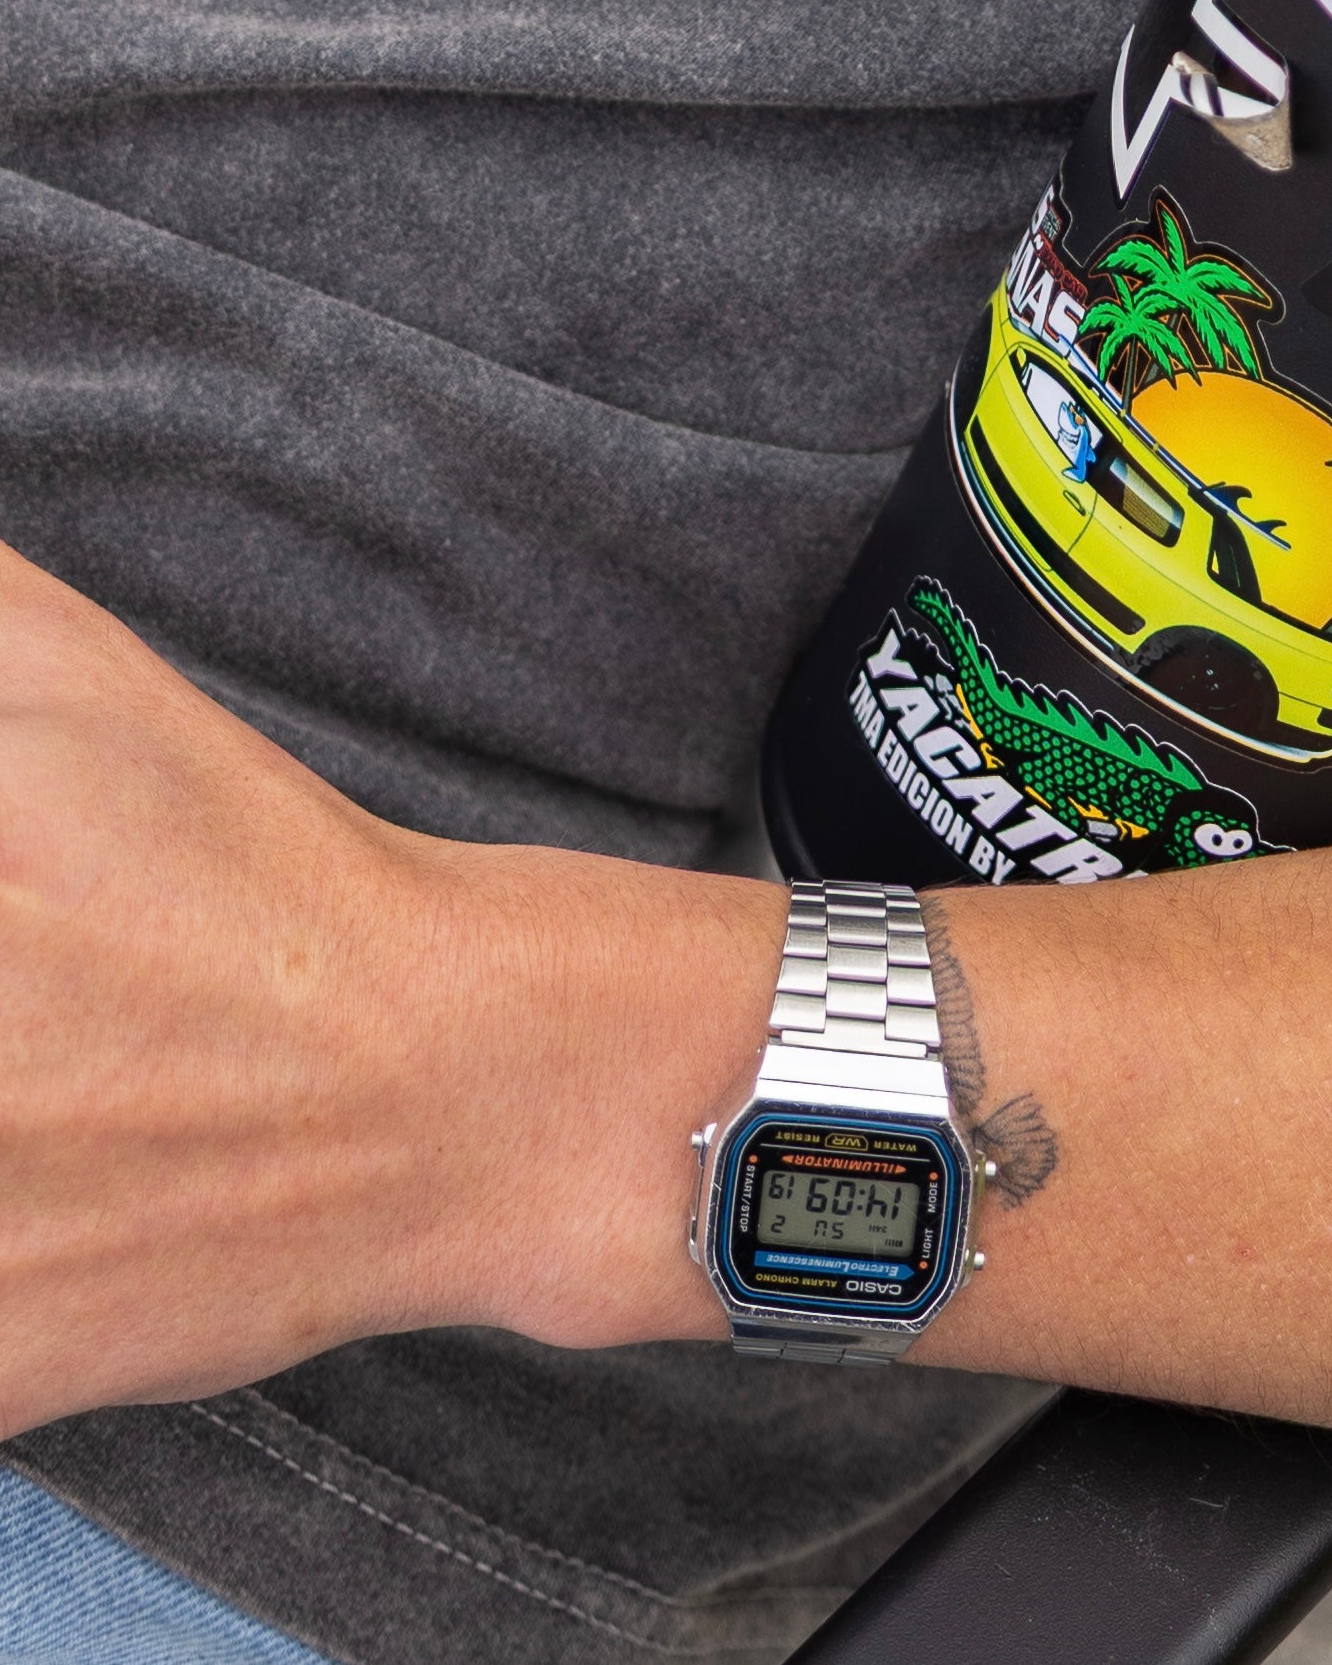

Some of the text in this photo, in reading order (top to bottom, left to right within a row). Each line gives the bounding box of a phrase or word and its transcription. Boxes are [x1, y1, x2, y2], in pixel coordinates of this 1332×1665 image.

[867, 628, 1149, 884] YACATR
[877, 728, 973, 855] EDICION
[969, 835, 1016, 886] BY
[775, 1131, 917, 1152] WATER WR RESIST
[795, 1154, 898, 1174] ILLUMINATOR
[740, 1164, 755, 1233] START/STOP
[927, 1182, 938, 1213] MODE
[921, 1228, 933, 1258] LIGHT
[756, 1272, 902, 1295] CASIO ALARM CHRONO
